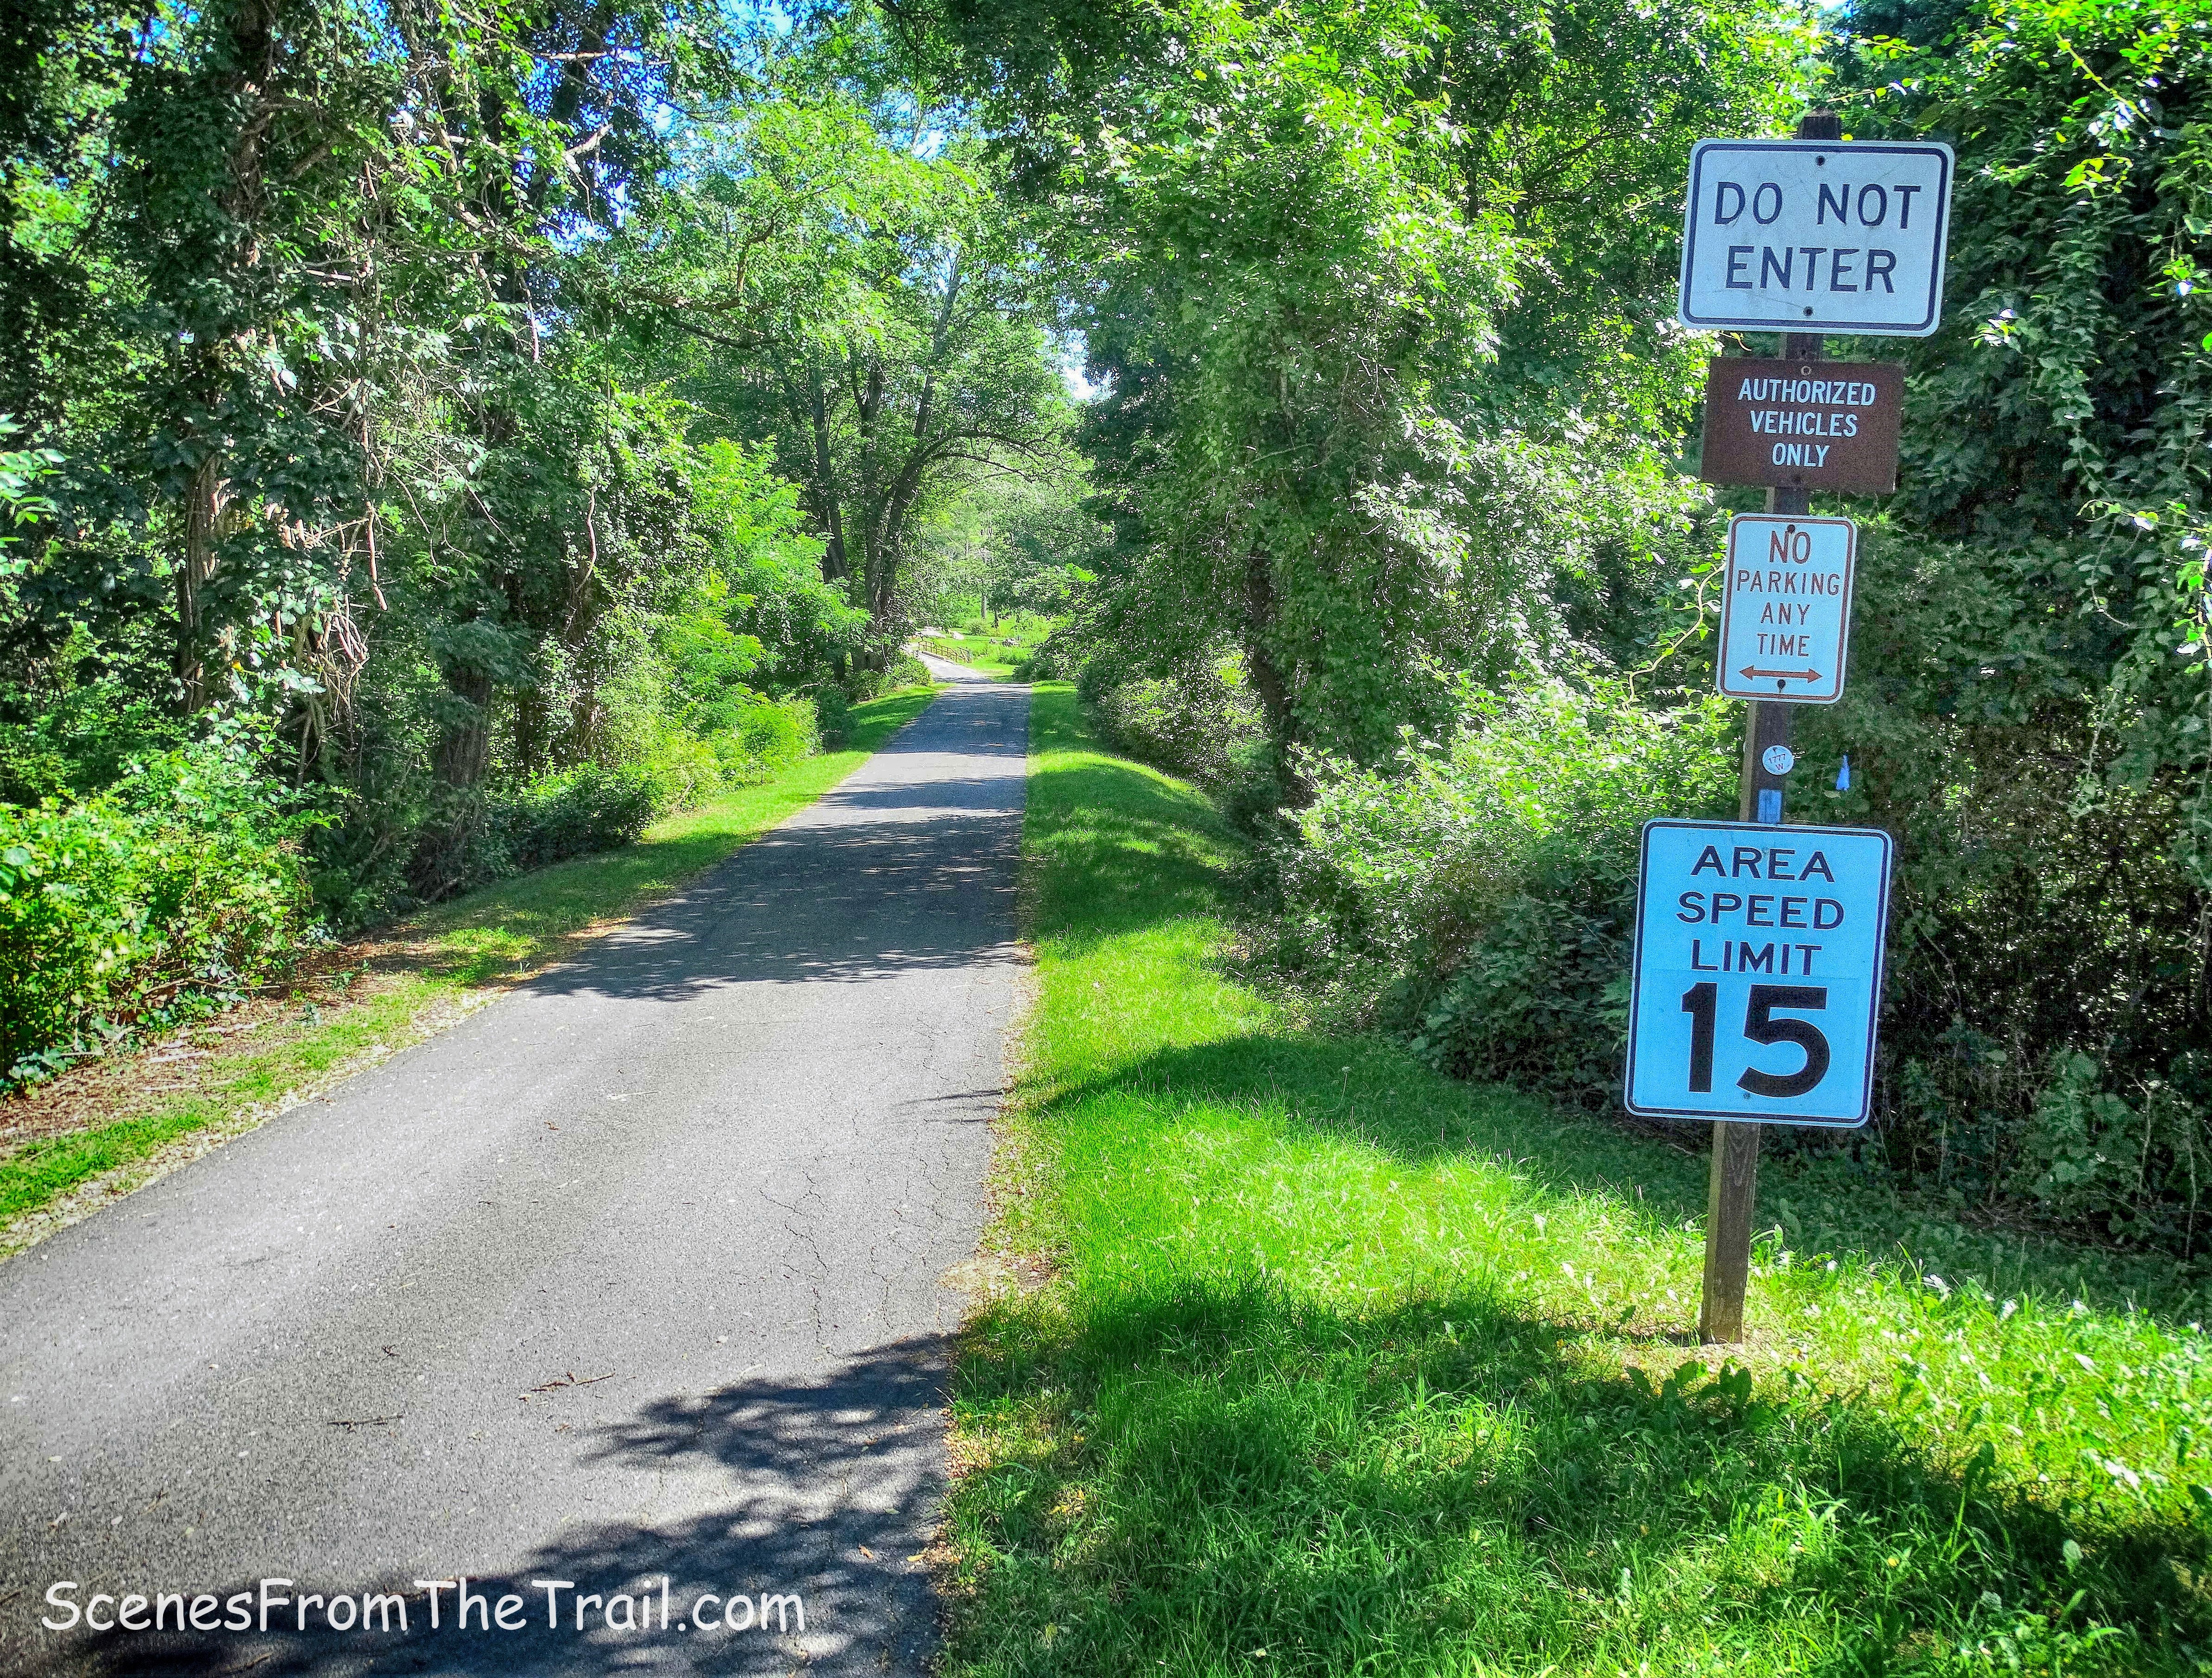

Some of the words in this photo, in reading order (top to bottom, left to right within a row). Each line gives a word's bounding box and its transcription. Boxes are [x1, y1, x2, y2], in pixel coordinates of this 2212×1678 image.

[1714, 181, 1783, 225] DO
[1817, 183, 1921, 229] NOT
[1725, 245, 1897, 294] ENTER
[1738, 378, 1876, 406] AUTHORIZED
[1750, 410, 1858, 437] VEHICLES
[1772, 443, 1829, 467] ONLY
[1769, 531, 1811, 564] NO
[1736, 570, 1840, 596] PARKING
[1760, 602, 1810, 625] ANY
[1757, 633, 1810, 657] TIME
[1690, 845, 1835, 882] AREA
[1676, 892, 1844, 930] SPEED
[1691, 939, 1822, 976] LIMIT
[1681, 981, 1831, 1098] 15
